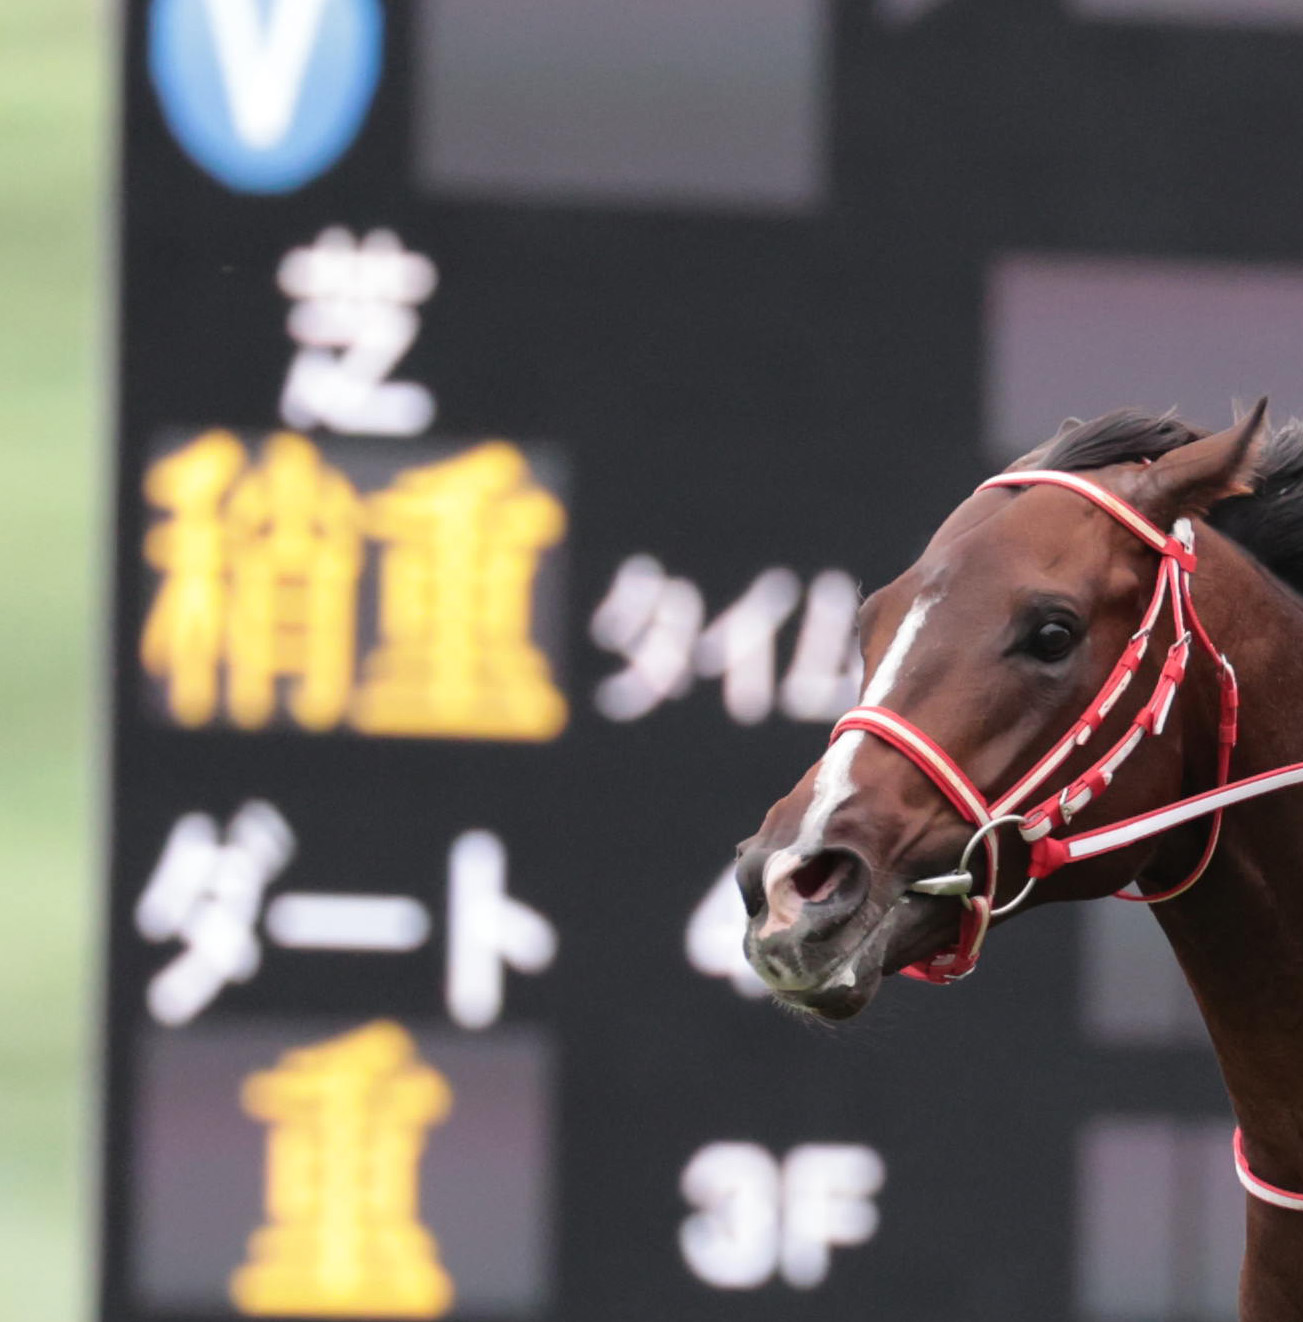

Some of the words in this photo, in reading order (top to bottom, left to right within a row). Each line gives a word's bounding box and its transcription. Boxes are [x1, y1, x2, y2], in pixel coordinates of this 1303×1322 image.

[277, 227, 437, 437] 芝
[142, 428, 568, 742] 稍重
[136, 801, 557, 1030] ダート
[231, 1020, 454, 1319] 重
[679, 1140, 885, 1290] 3F
